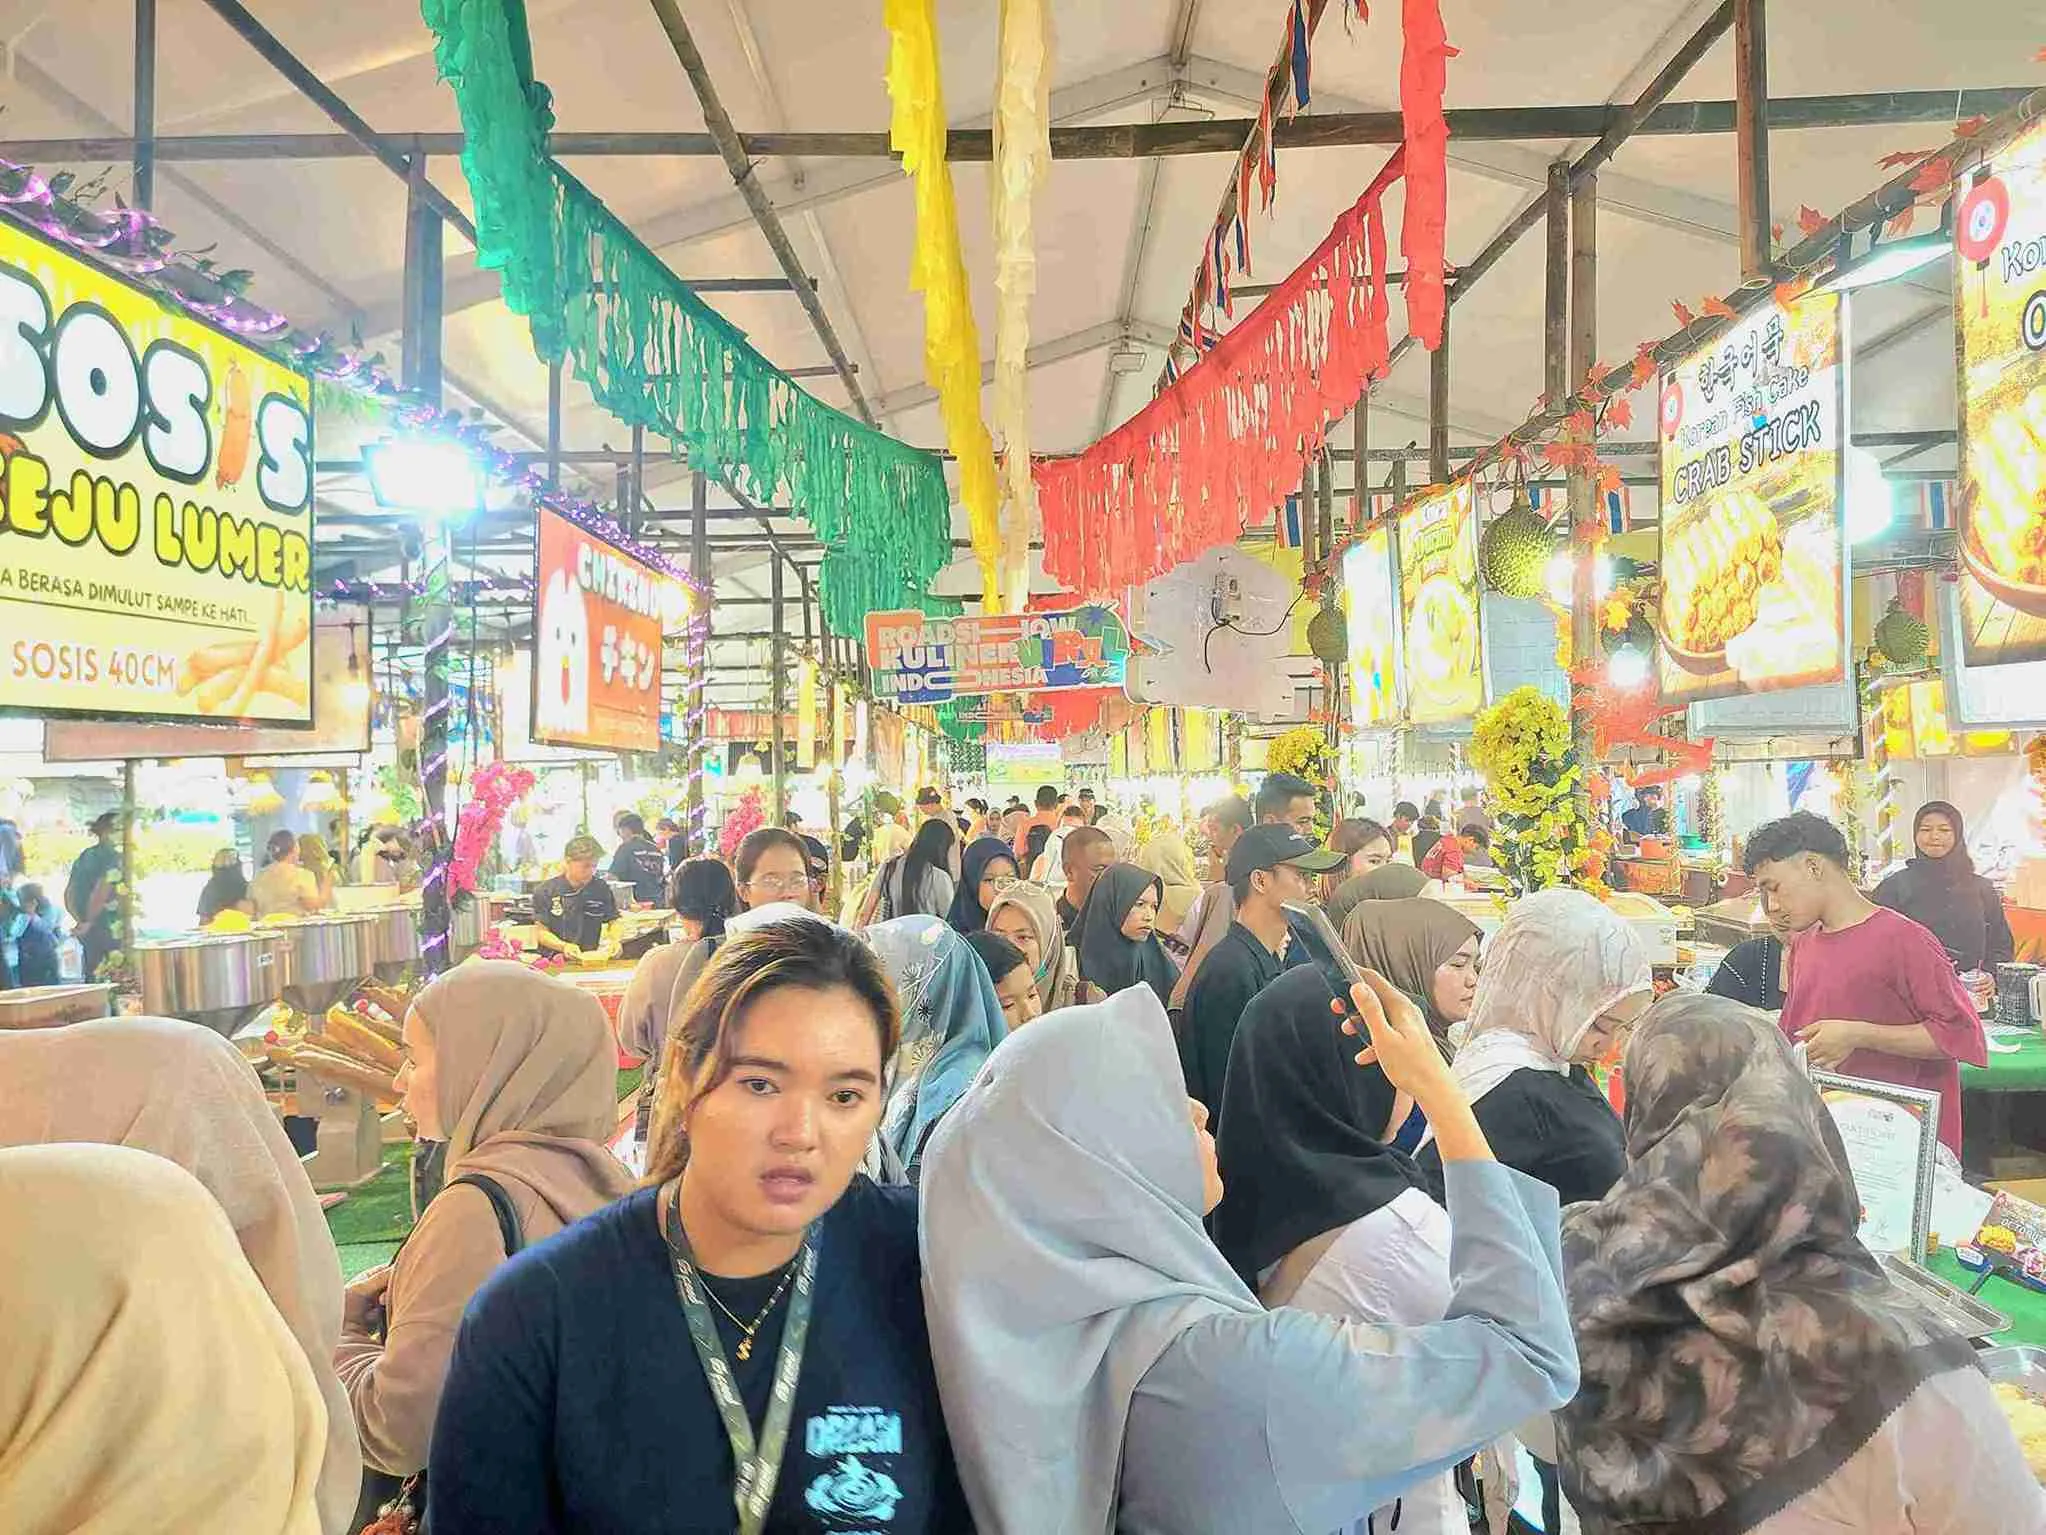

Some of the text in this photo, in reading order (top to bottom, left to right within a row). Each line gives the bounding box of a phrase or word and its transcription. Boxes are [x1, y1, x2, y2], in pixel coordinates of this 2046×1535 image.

[1680, 363, 1809, 452] Korean Fish Cake
[1673, 400, 1822, 504] CRAB STICK
[0, 451, 311, 593] EJU LUMER
[19, 568, 84, 598] BERASA
[88, 581, 152, 609] DIMULUT
[156, 593, 199, 618] SAMPE
[201, 602, 217, 621] KE
[12, 640, 177, 689] SOSIS 40CM
[600, 624, 655, 692] チキン
[880, 639, 1018, 670] KULINER
[881, 668, 1049, 693] INDONESIA
